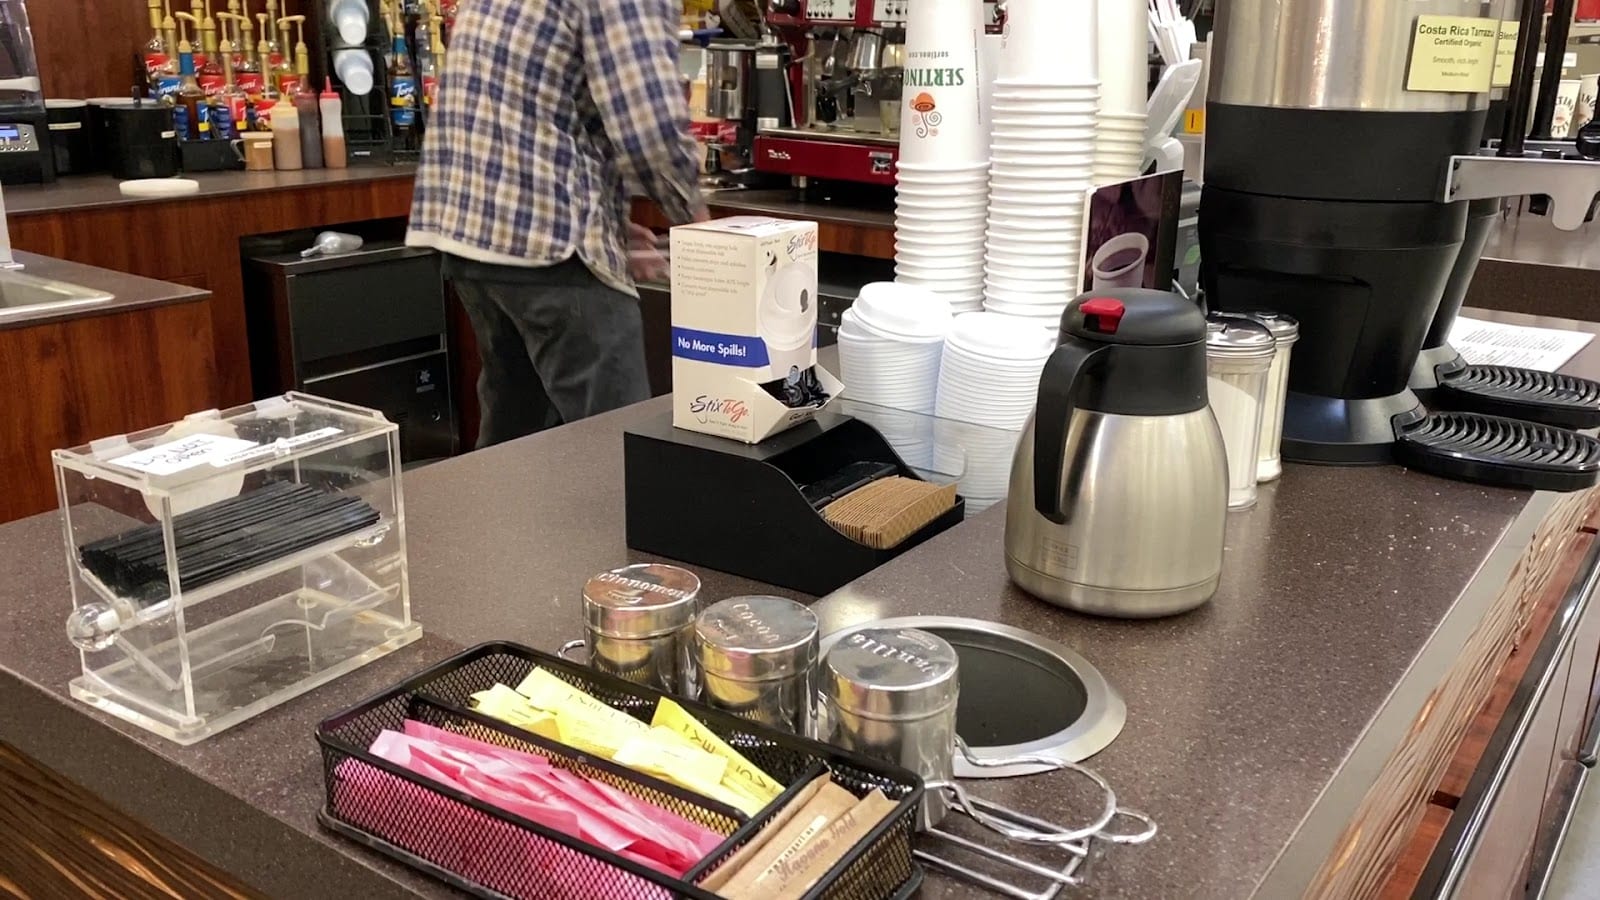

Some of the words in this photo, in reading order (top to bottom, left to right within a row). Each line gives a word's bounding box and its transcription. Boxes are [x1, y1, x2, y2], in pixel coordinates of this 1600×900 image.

[1419, 24, 1447, 35] Costa
[1449, 26, 1469, 36] Rica
[678, 337, 691, 349] No
[692, 340, 716, 353] More
[718, 343, 747, 357] Spills!
[732, 603, 780, 643] Cocoa
